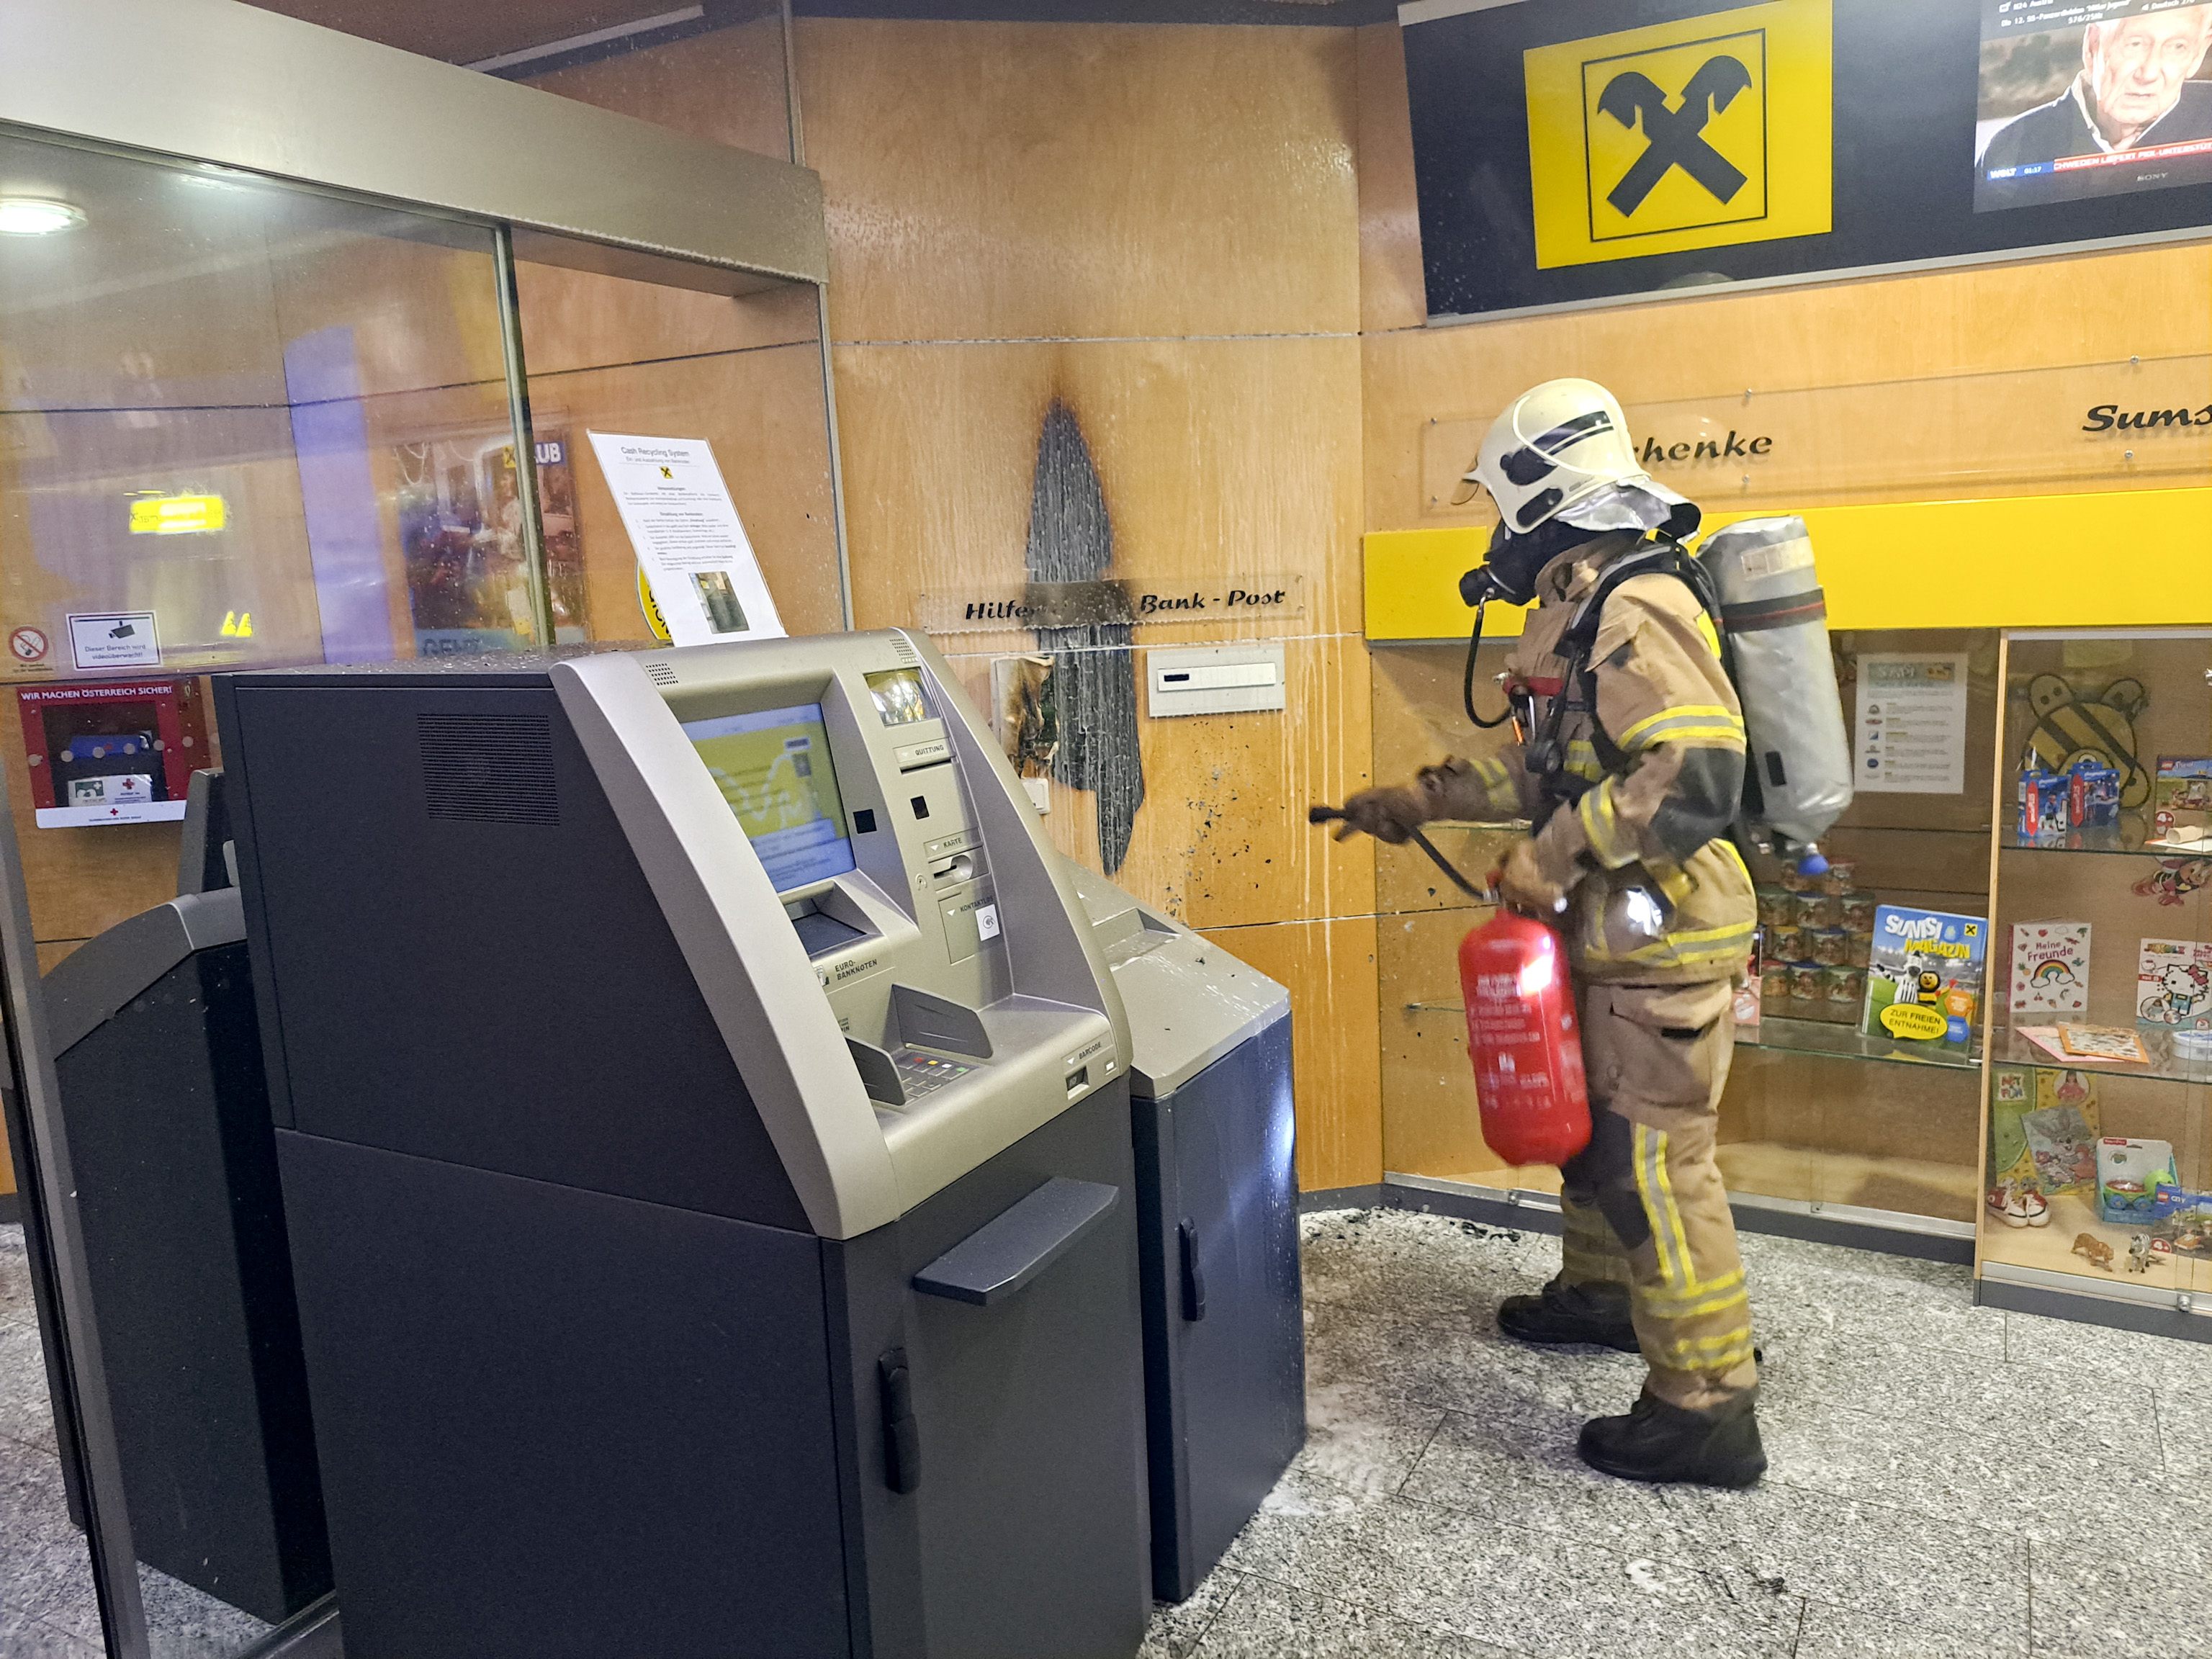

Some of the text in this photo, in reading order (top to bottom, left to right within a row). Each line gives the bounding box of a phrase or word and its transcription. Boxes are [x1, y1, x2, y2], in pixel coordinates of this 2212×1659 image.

[2137, 172, 2169, 181] SONY
[1634, 430, 1773, 463] henke
[1141, 592, 1205, 614] Bank
[1228, 589, 1285, 606] Post
[42, 691, 80, 699] MACHEN
[81, 688, 137, 698] ÖSTERREICH
[138, 686, 172, 695] SICHER!
[914, 744, 945, 756] QUITTUNG
[943, 837, 963, 849] KARTE
[960, 894, 995, 914] KONTAKTLOS
[1885, 914, 1943, 940] SUMSI
[1905, 938, 1971, 959] MAGAZIN
[2036, 940, 2062, 950] Meine
[2028, 945, 2074, 962] Freunde
[835, 959, 856, 972] EURO-
[837, 958, 878, 981] BANKNOTEN
[1890, 1009, 1941, 1025] ZUR FREIEN
[1889, 1018, 1939, 1034] ENTNAHME!
[1079, 1041, 1102, 1059] BARCODE
